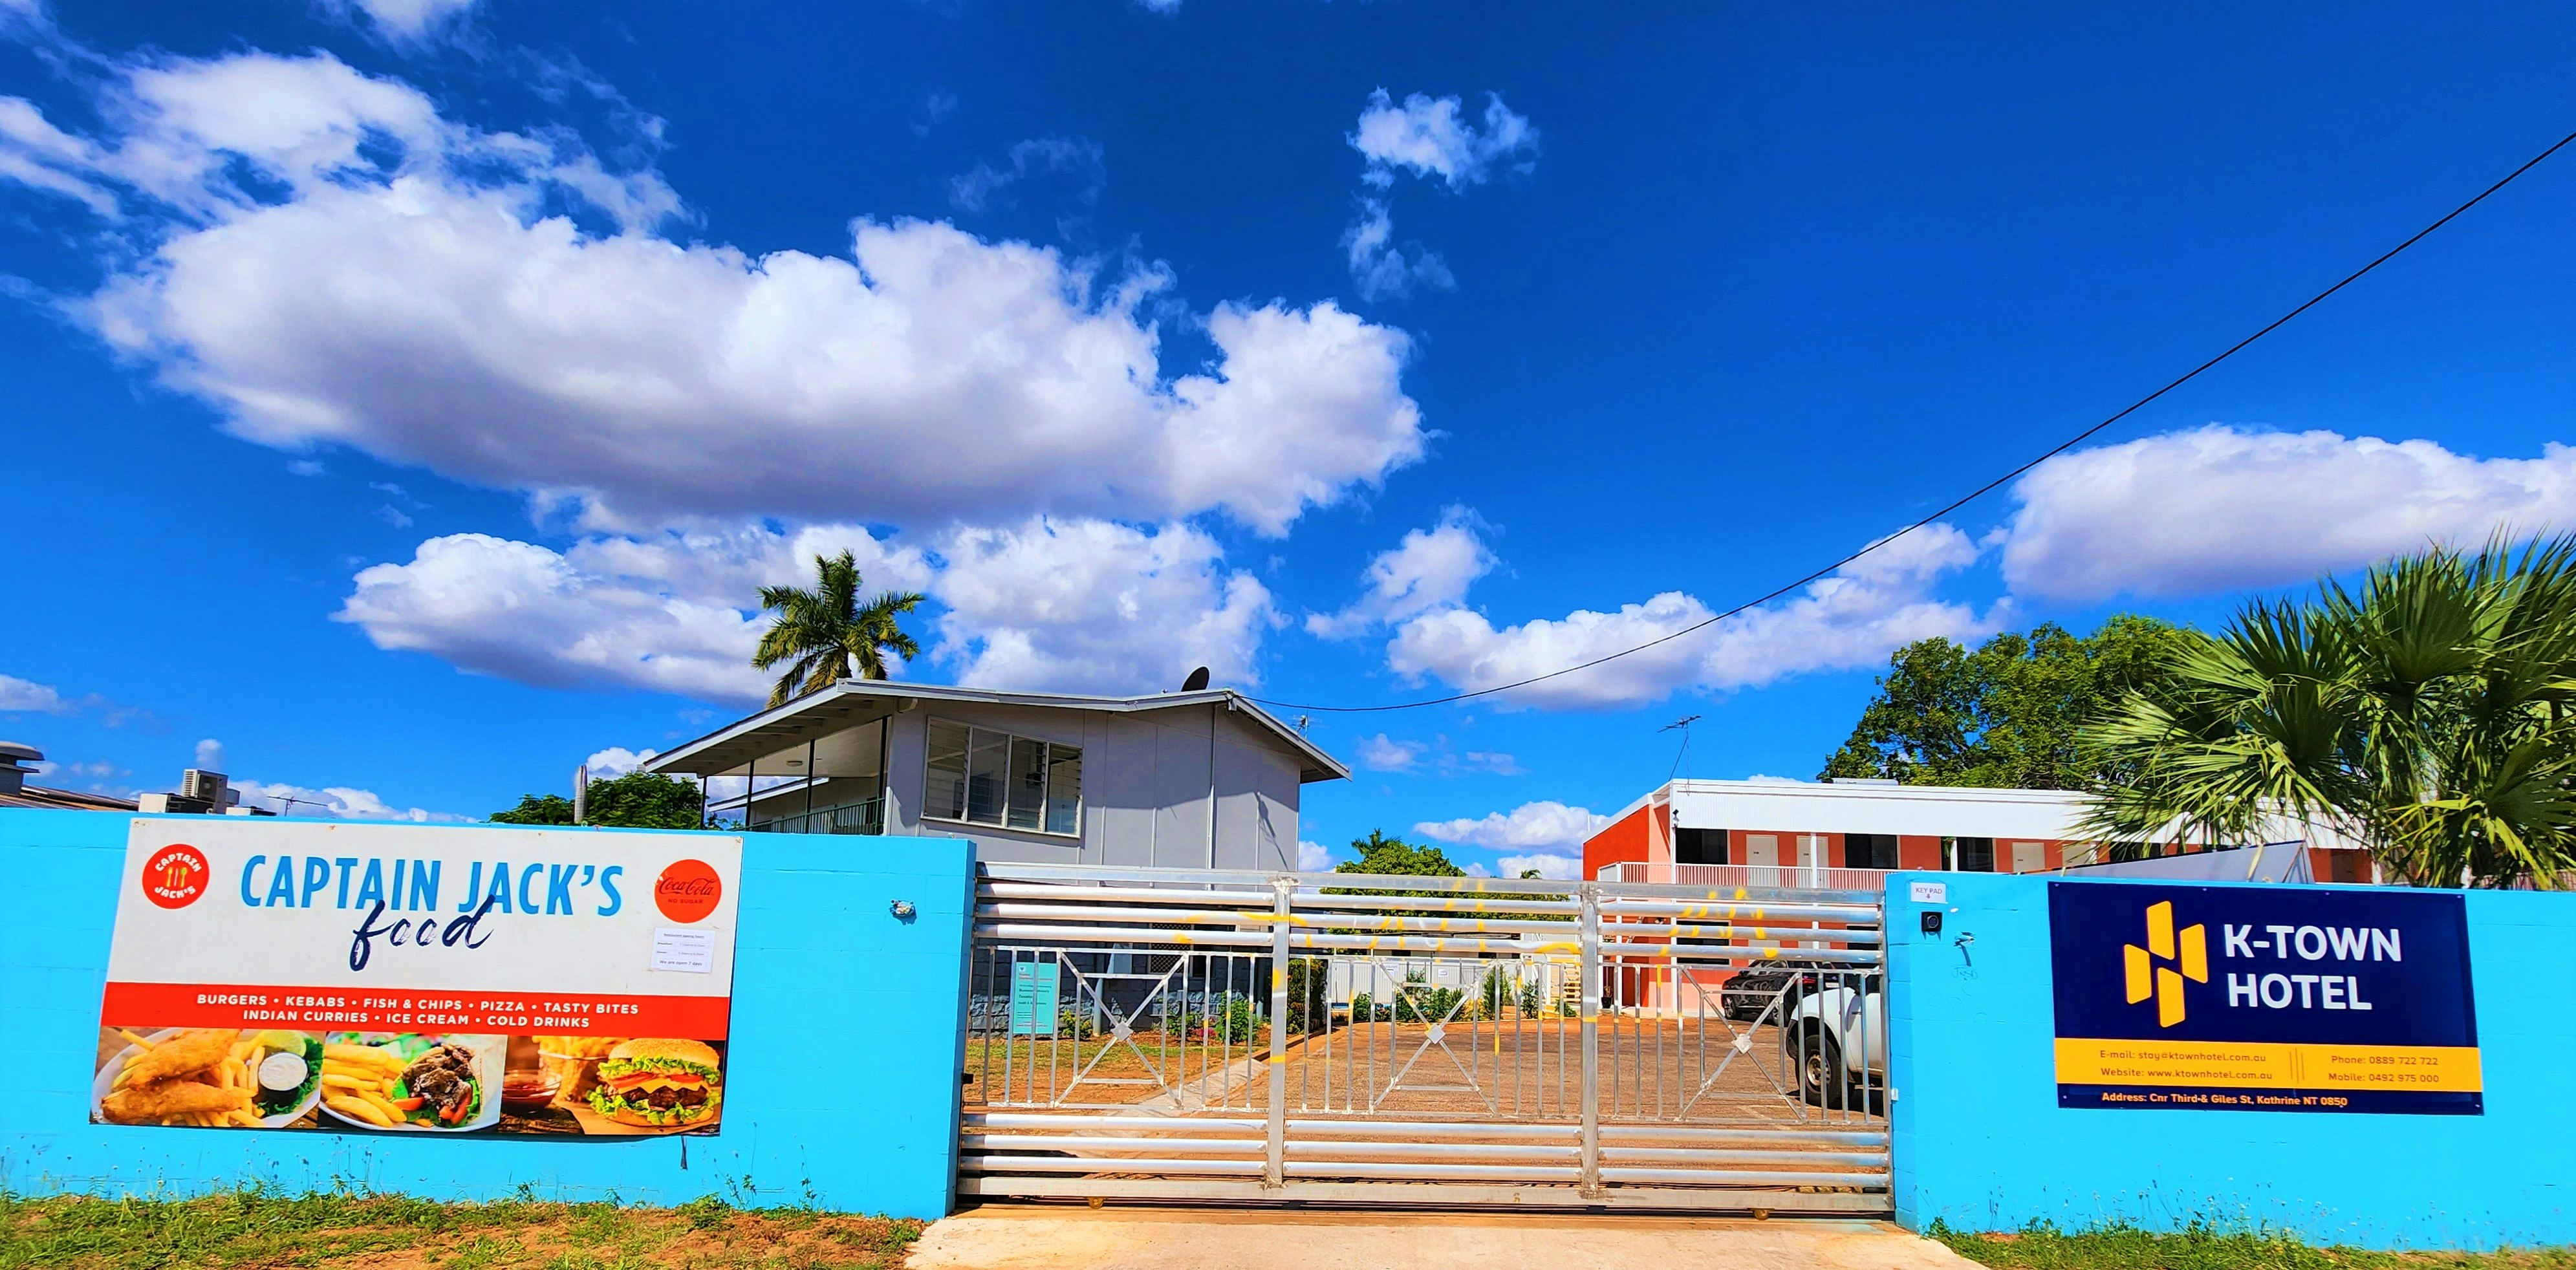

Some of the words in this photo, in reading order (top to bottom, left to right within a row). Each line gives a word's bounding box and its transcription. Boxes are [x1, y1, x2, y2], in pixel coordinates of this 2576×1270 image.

[155, 852, 202, 872] CAPTAIN
[154, 885, 196, 899] JACK'S
[240, 854, 441, 912] CAPTAIN
[457, 861, 623, 917] JACK'S
[658, 877, 717, 896] Coca-Cola
[349, 894, 495, 972] food
[2224, 923, 2402, 962] K-TOWN
[2227, 972, 2372, 1011] HOTEL
[197, 994, 267, 1006] BURGERS
[285, 996, 345, 1007] KEBABS
[363, 998, 397, 1009] FISH
[402, 998, 412, 1009] &
[417, 999, 462, 1010] CHIPS
[480, 1001, 525, 1012] PIZZA
[543, 1002, 590, 1014] TASTY
[596, 1004, 638, 1015] BITES
[243, 1009, 298, 1020] INDIAN
[303, 1011, 369, 1023] CURRIES
[386, 1013, 411, 1024] ICE
[417, 1014, 469, 1025] CREAM
[487, 1015, 528, 1026] COLD
[533, 1017, 590, 1028] DRINKS
[2100, 1050, 2135, 1059] E-mail:
[2138, 1051, 2266, 1062] stay@ktownhotel.com.au
[2332, 1055, 2366, 1064] Phone:
[2369, 1056, 2395, 1064] 0889
[2398, 1057, 2417, 1065] 722
[2101, 1068, 2144, 1077] Website:
[2147, 1069, 2273, 1079] www.ktownhotel.com.au
[2328, 1073, 2365, 1081] Mobile:
[2368, 1073, 2394, 1082] 0492
[2398, 1074, 2416, 1082] 975
[2420, 1074, 2440, 1082] 000
[2102, 1092, 2147, 1102] Address:
[2149, 1093, 2168, 1103] Cnr
[2211, 1094, 2238, 1104] Giles
[2240, 1095, 2255, 1104] St,
[2257, 1095, 2300, 1104] Kathrine
[2302, 1096, 2318, 1105] NT
[2320, 1097, 2348, 1106] 0850
